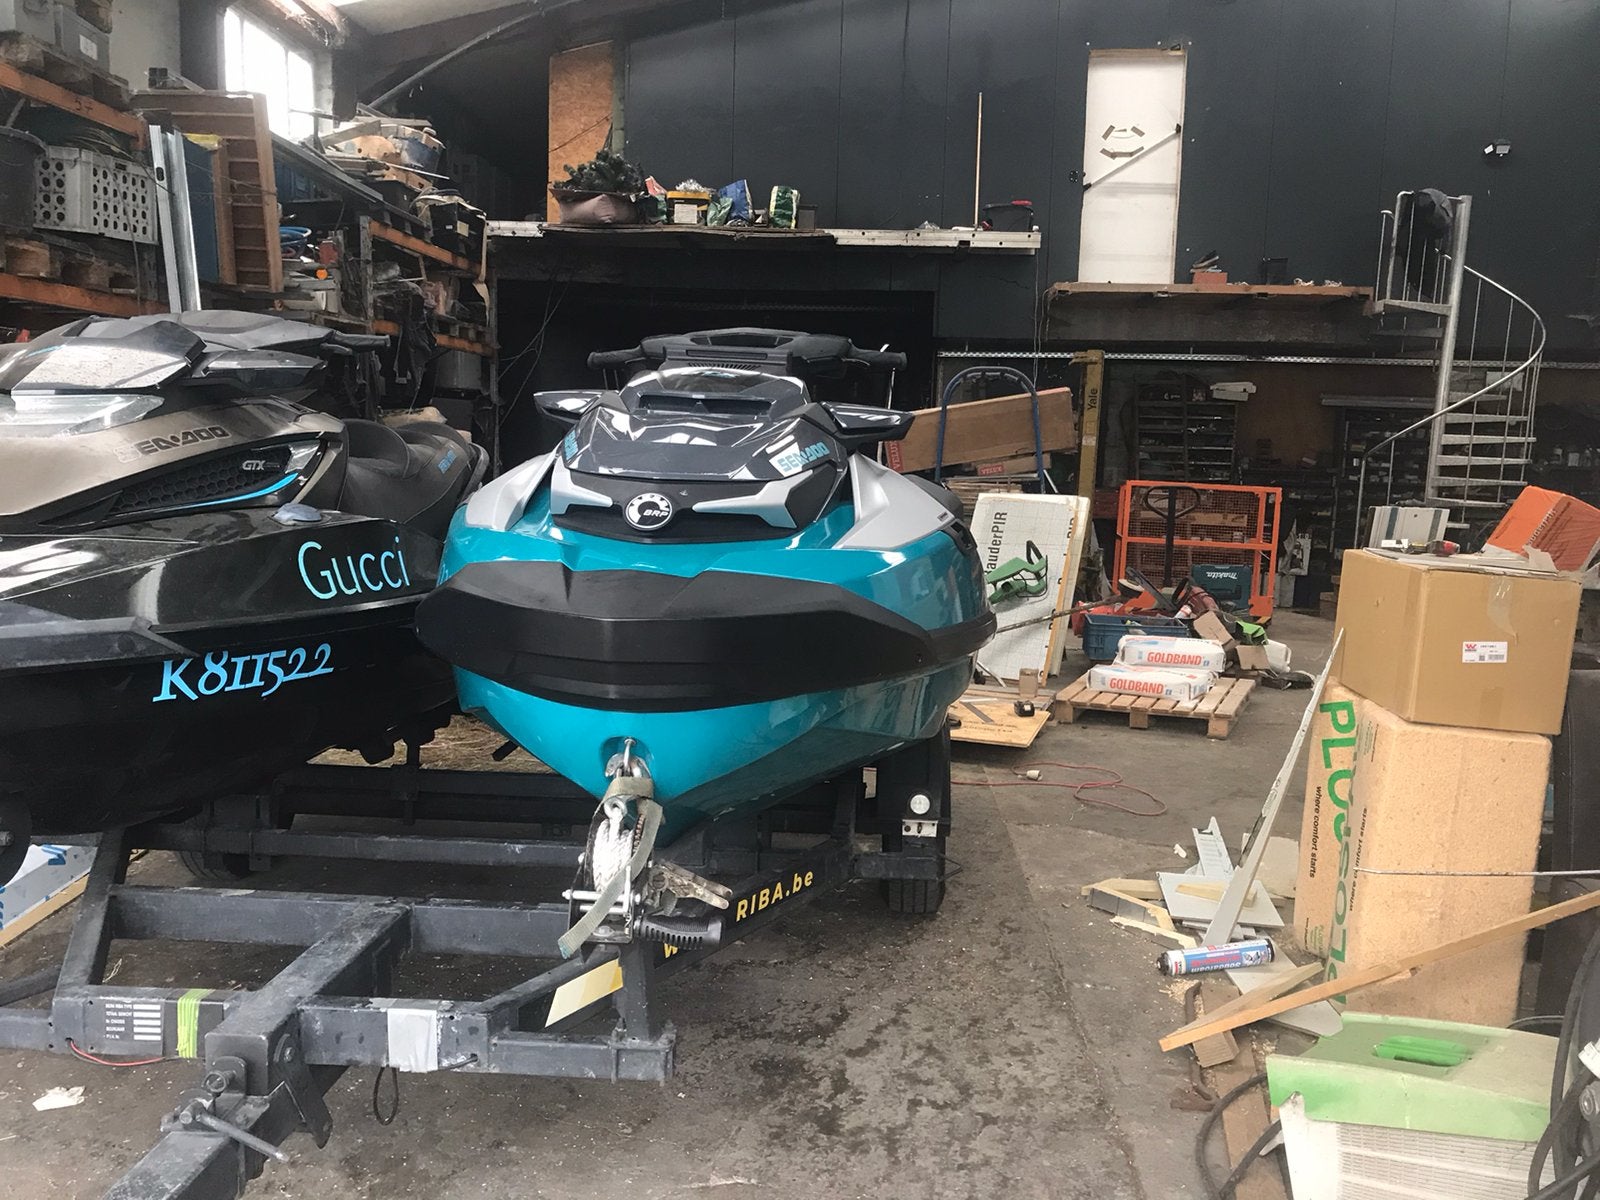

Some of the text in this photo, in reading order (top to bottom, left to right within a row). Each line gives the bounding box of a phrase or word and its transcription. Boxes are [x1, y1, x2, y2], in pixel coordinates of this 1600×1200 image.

[1087, 388, 1098, 411] Yale
[242, 460, 265, 470] GTX
[643, 508, 669, 517] BRP
[297, 536, 411, 600] Gucci
[1147, 651, 1202, 666] GOLDBAND
[1109, 678, 1164, 695] GOLDBAND
[1309, 786, 1322, 878] where comfort starts
[736, 871, 814, 922] RIBA.be
